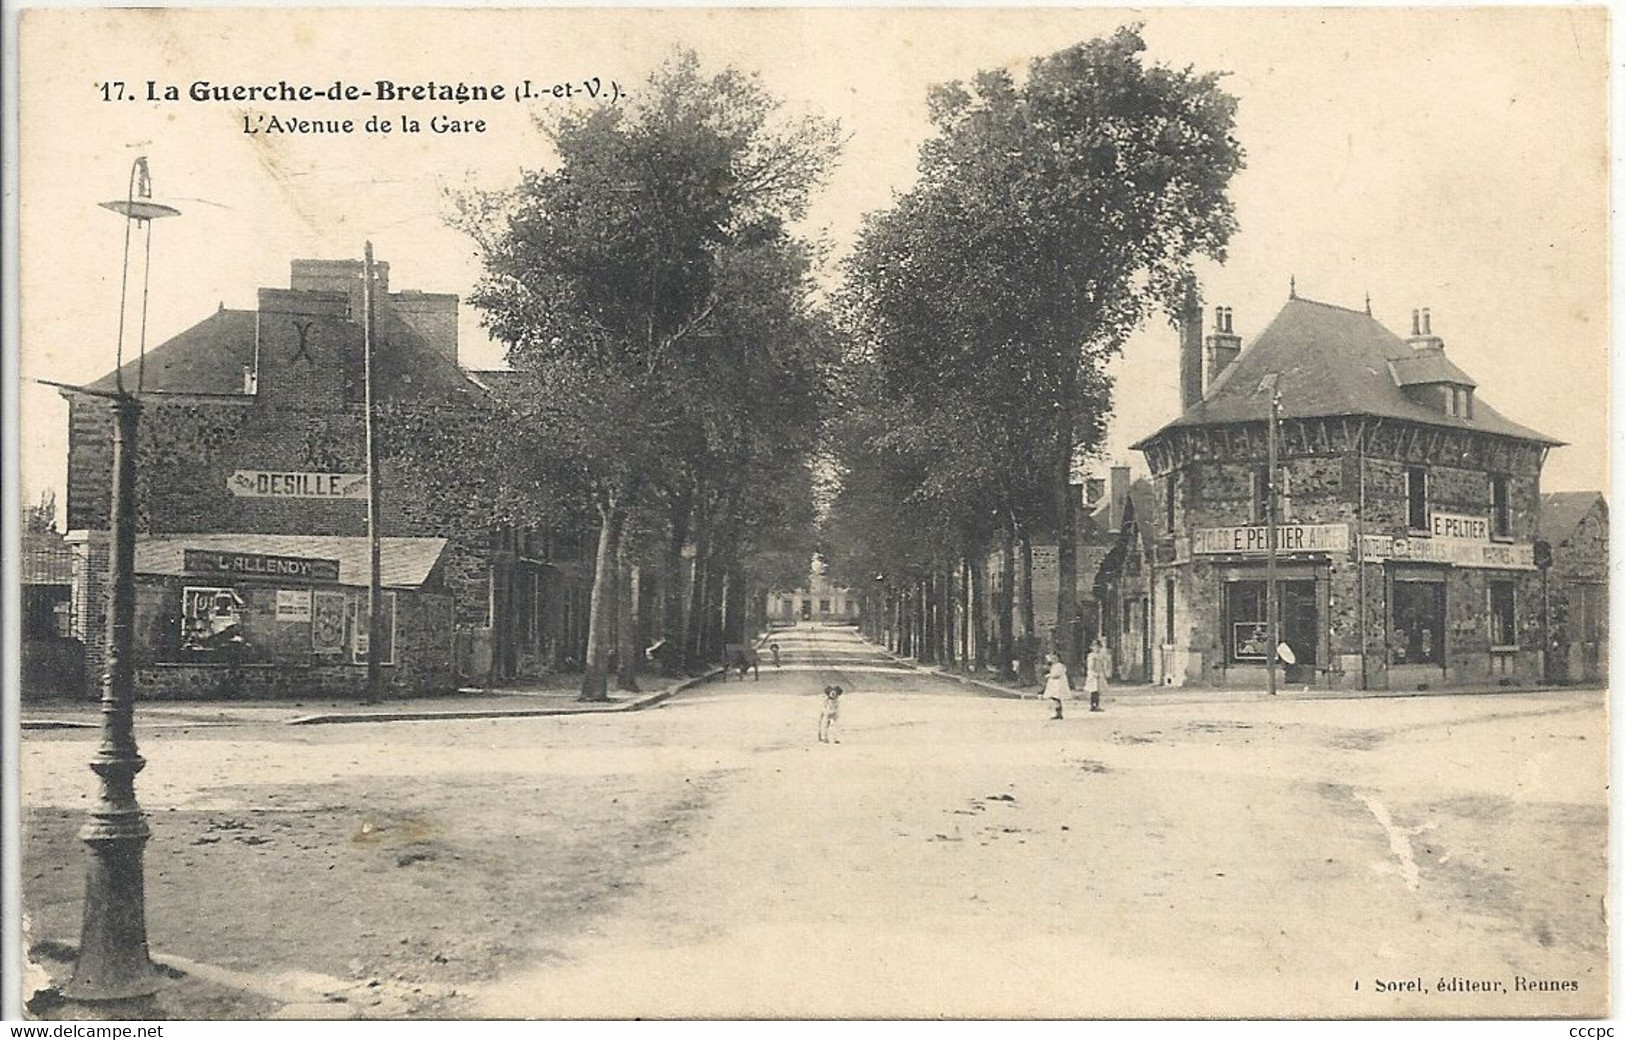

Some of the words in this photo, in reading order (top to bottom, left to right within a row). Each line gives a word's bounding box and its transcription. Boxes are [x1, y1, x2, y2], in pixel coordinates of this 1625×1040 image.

[257, 474, 341, 495] DESILLE
[1248, 527, 1304, 550] PELIER
[1445, 519, 1486, 538] PELTIER
